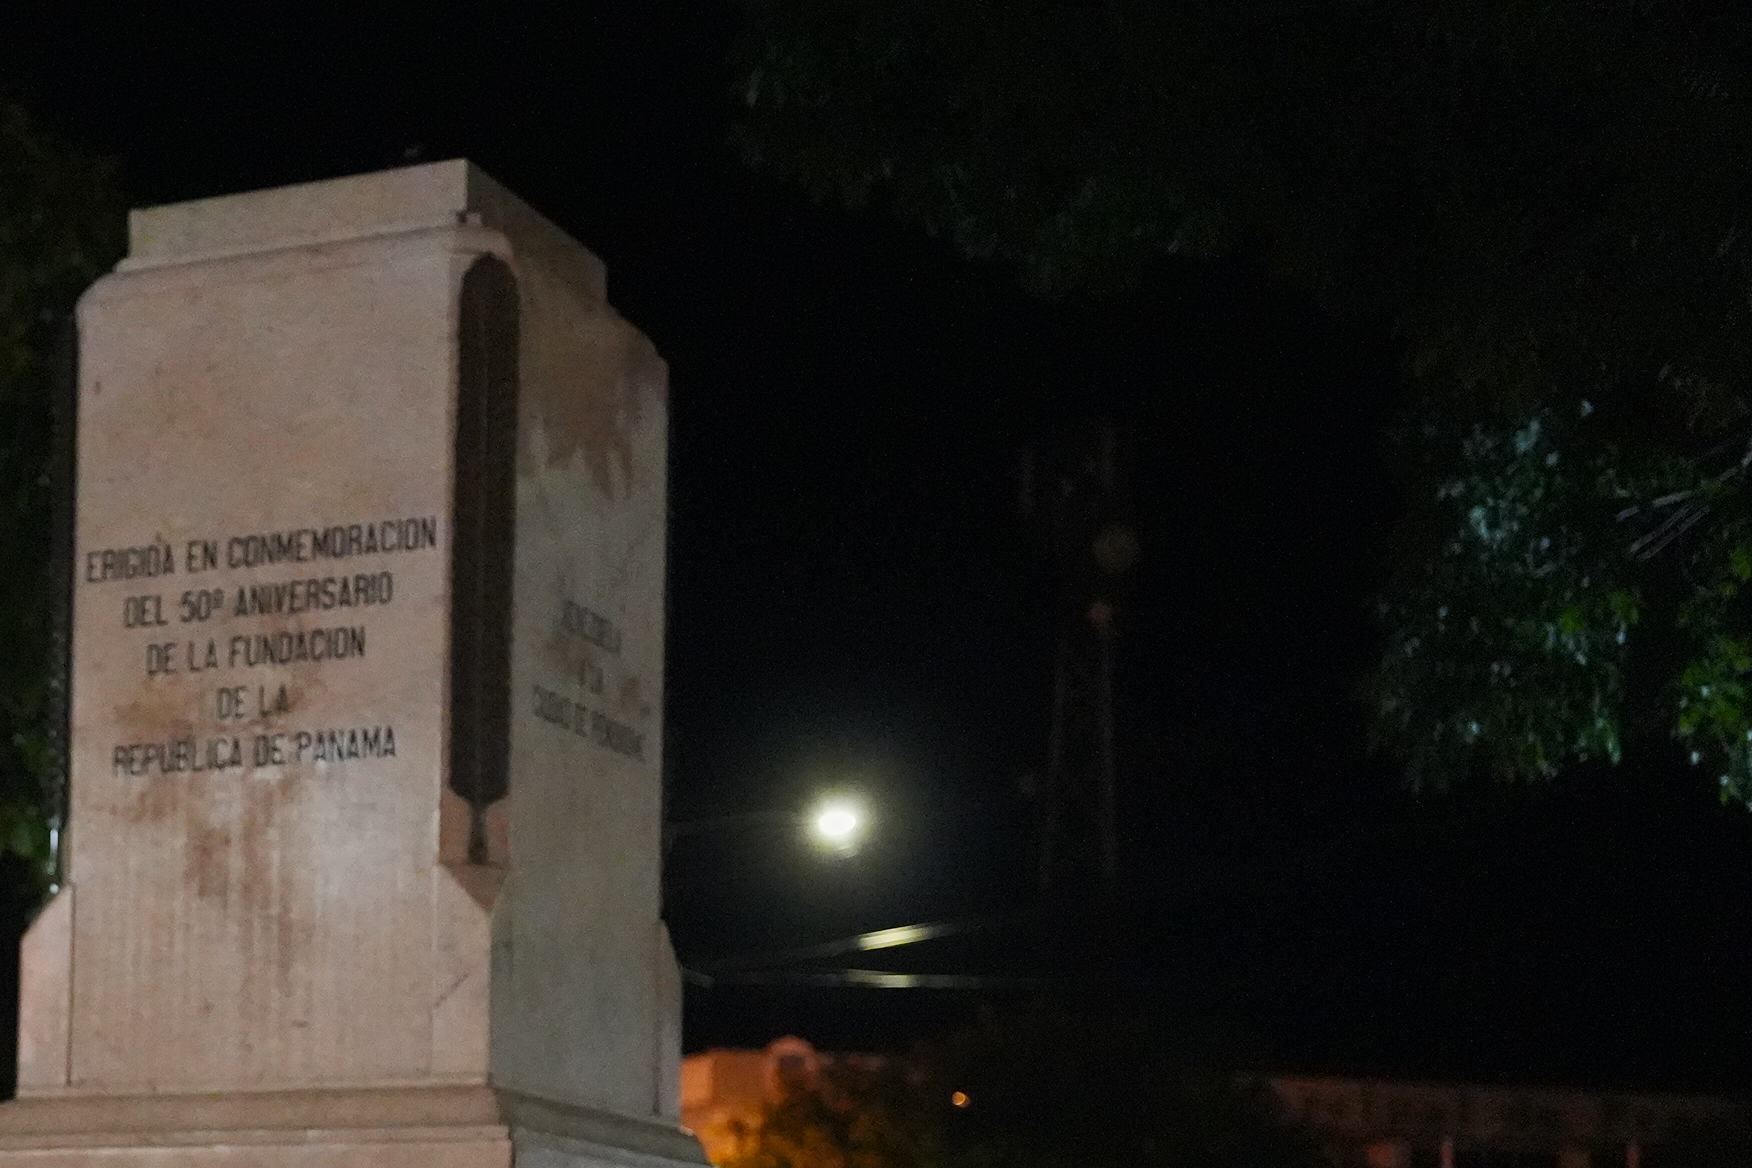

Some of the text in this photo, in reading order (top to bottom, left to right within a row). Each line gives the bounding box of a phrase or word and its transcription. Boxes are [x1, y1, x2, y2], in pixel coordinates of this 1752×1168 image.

[187, 540, 217, 573] EN
[227, 516, 436, 569] CONMEMORACION
[124, 595, 168, 628] DEL
[235, 571, 393, 616] ANIVERSARIO
[147, 627, 365, 675] DE LA FUNDACION
[217, 684, 289, 719] DE LA
[112, 725, 396, 776] REPUBLICA DE PANAMA
